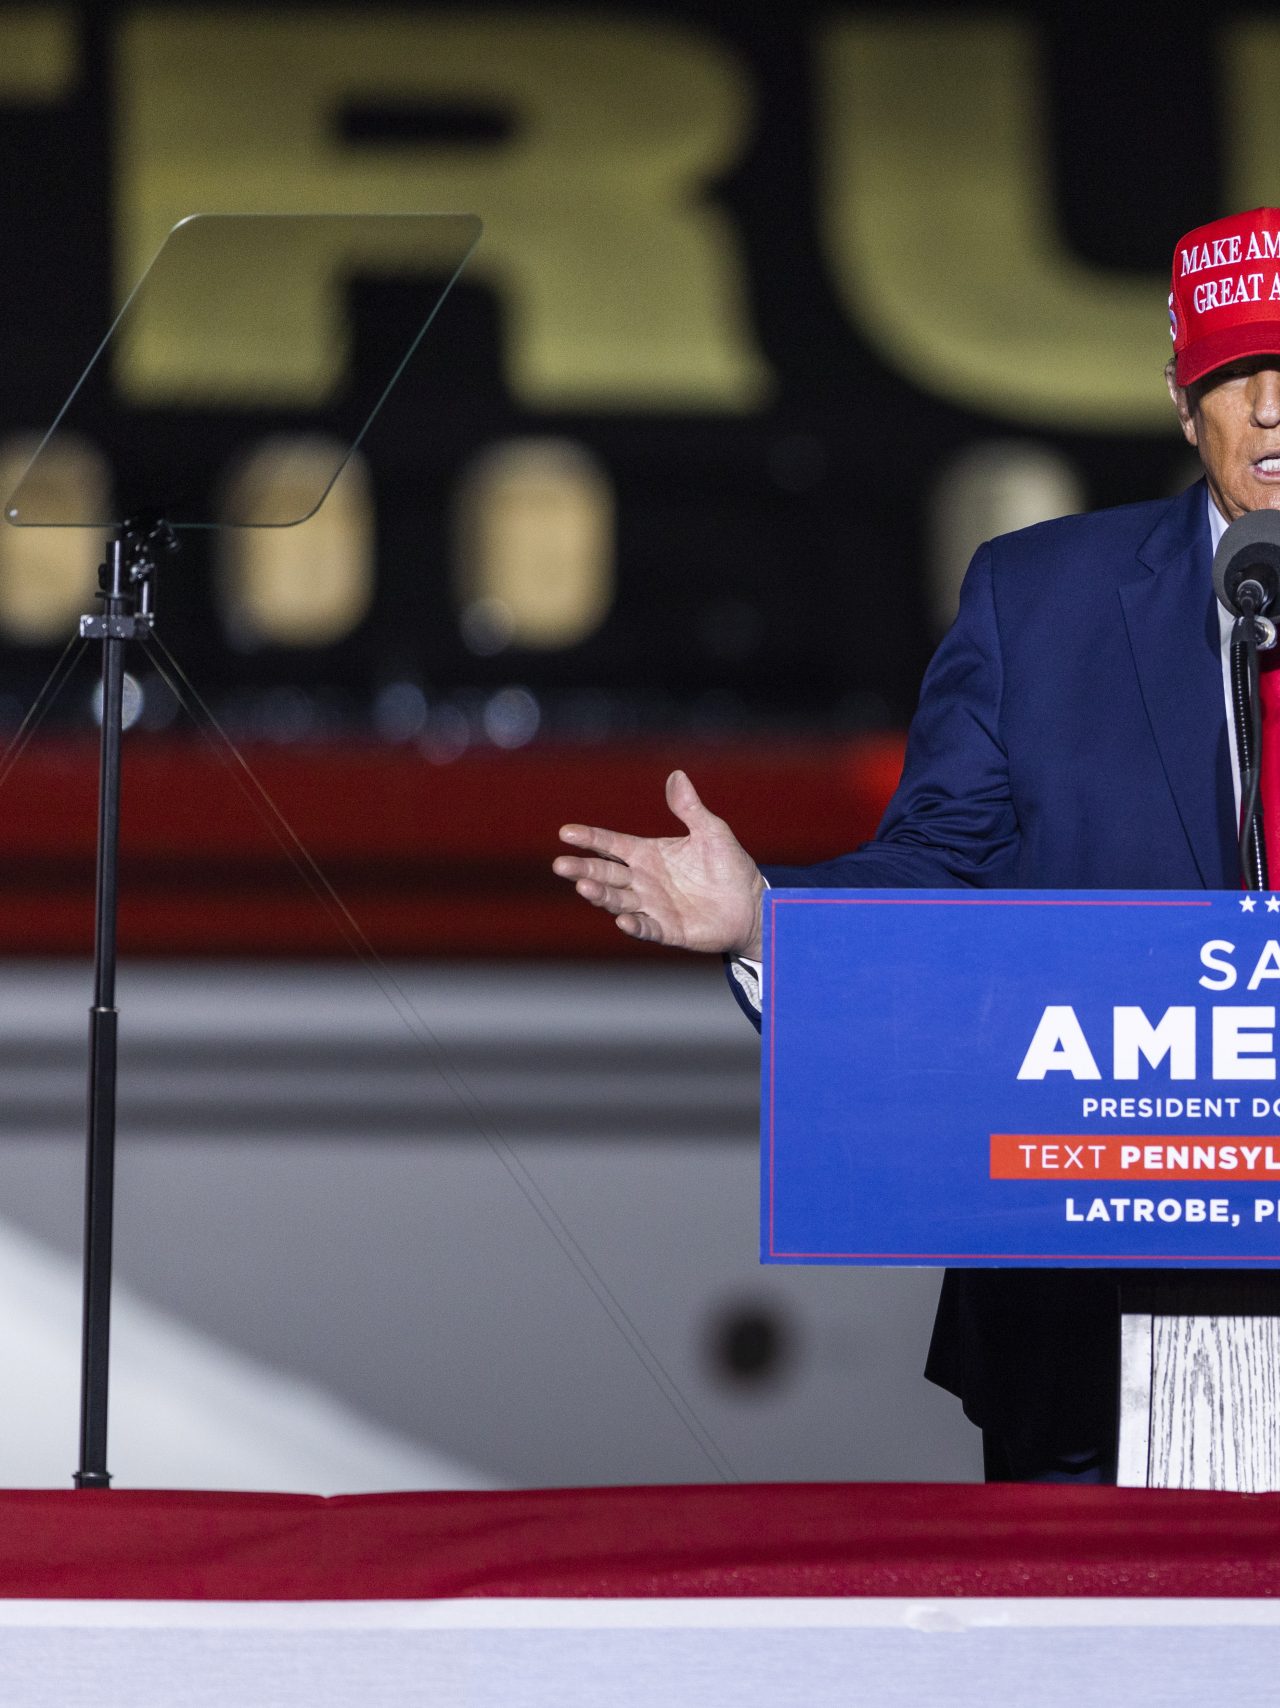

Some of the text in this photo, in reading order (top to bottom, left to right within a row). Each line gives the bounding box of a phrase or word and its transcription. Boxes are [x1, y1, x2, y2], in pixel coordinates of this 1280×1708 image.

[1180, 235, 1243, 277] MAKE
[1193, 273, 1264, 314] GREAT
[1082, 1096, 1241, 1118] PRESIDENT
[1018, 1144, 1107, 1169] TEXT
[1065, 1197, 1241, 1227] LATROBE,
